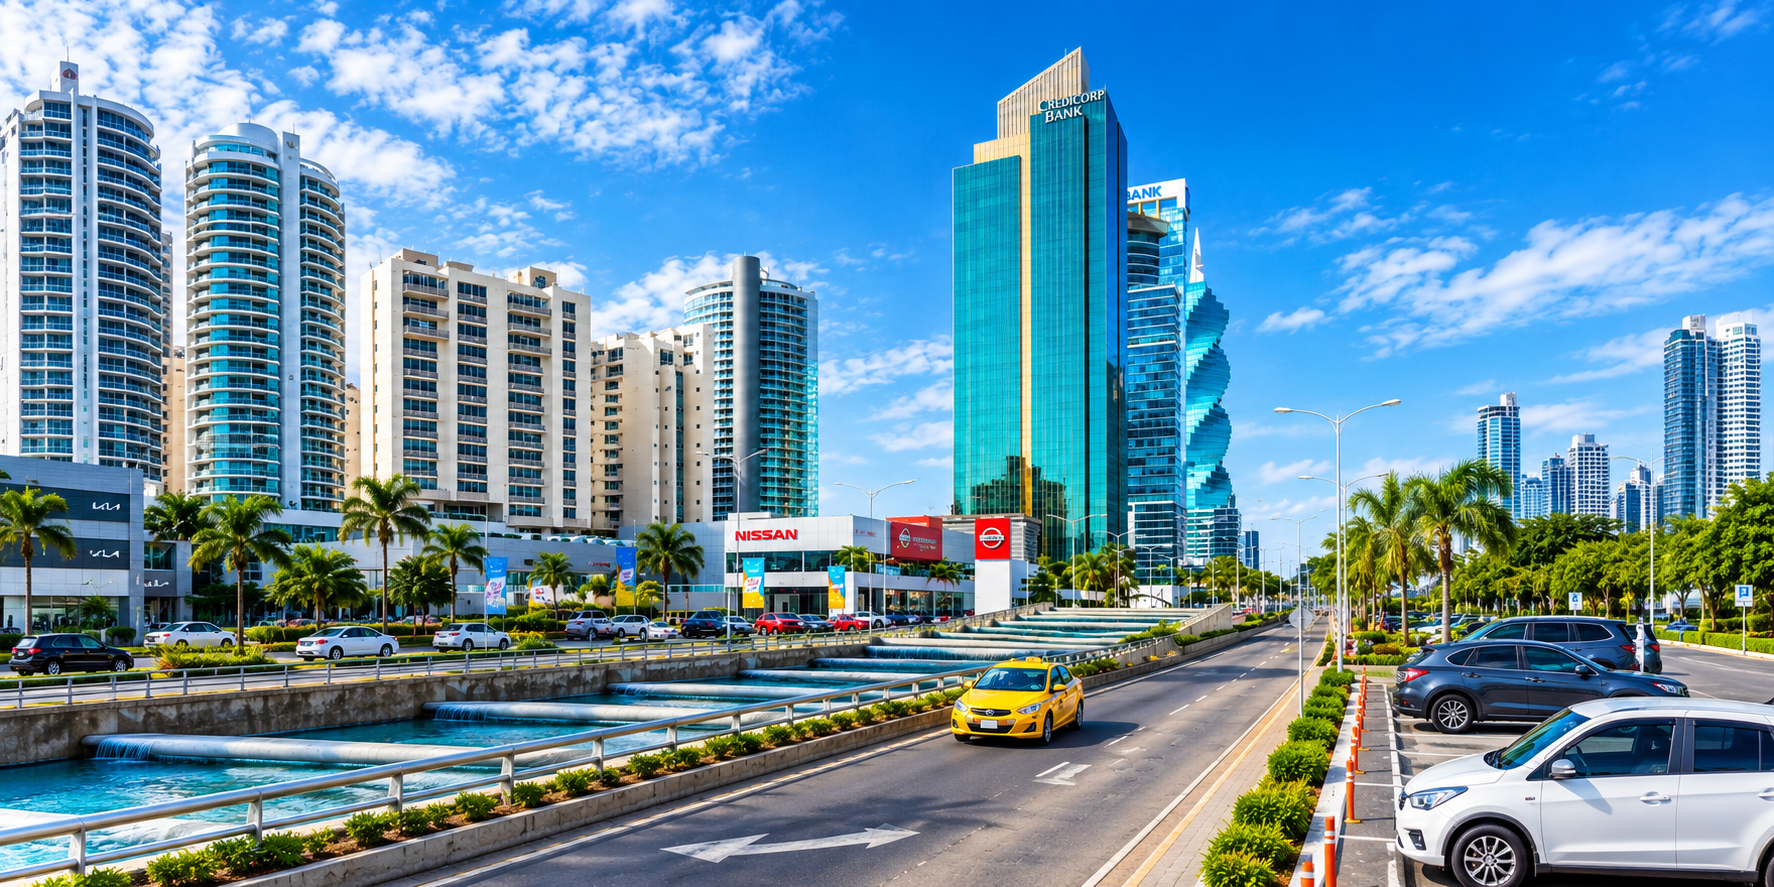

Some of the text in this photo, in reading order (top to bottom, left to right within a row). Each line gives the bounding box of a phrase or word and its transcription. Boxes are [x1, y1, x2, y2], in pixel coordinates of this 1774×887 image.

[1038, 89, 1105, 112] CREDICORP
[1045, 105, 1083, 124] BANK
[735, 529, 798, 541] NISSAN
